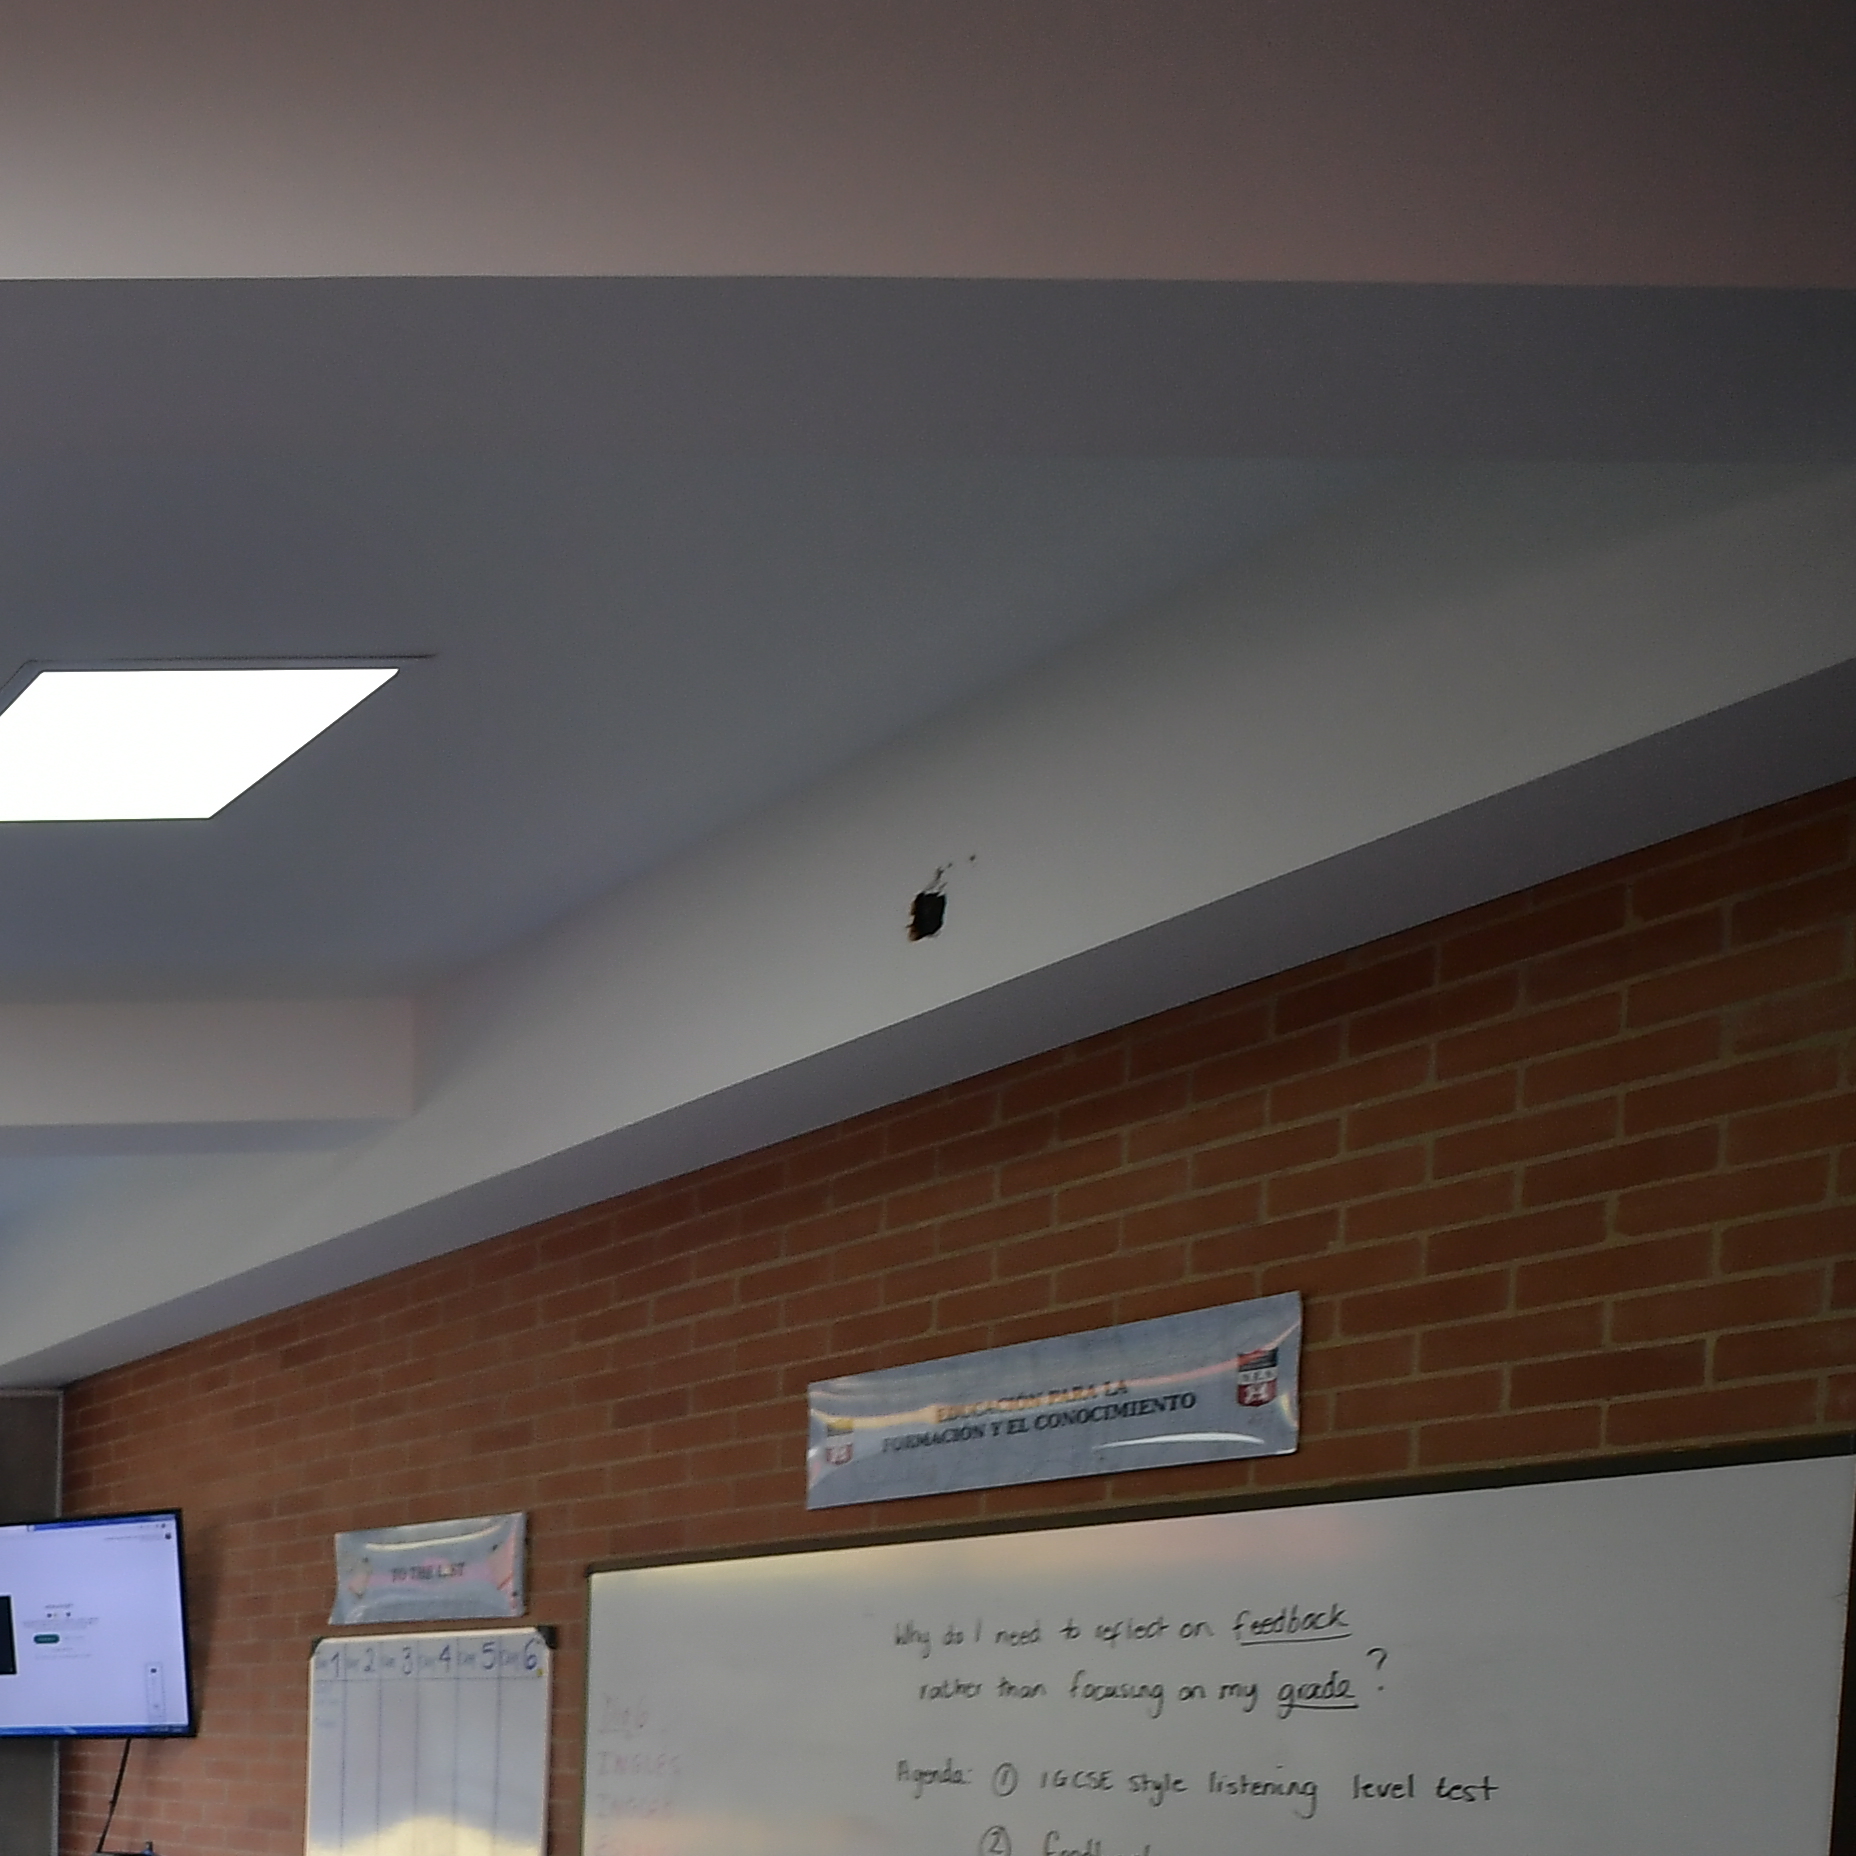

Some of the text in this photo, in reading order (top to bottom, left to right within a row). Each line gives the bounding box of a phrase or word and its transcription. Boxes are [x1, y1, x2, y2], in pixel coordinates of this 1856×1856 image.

[990, 1420, 1003, 1437] Y
[1007, 1417, 1030, 1435] EL
[1034, 1392, 1197, 1431] CONOCIMIENTO
[439, 1644, 452, 1674] 4
[482, 1641, 497, 1670] 5
[524, 1637, 538, 1671] 6
[894, 1622, 931, 1658] Why
[942, 1621, 965, 1646] do
[995, 1621, 1040, 1647] need
[1060, 1617, 1082, 1639] to
[1095, 1618, 1170, 1648] reflect
[1179, 1619, 1214, 1639] on
[1233, 1603, 1350, 1643] feedback
[918, 1678, 984, 1701] rather
[997, 1677, 1047, 1700] than
[1068, 1669, 1164, 1719] focusing
[1178, 1682, 1208, 1701] on
[1218, 1680, 1258, 1713] my
[1278, 1670, 1353, 1719] grade
[1040, 1769, 1114, 1792] IGCSE
[1128, 1770, 1188, 1807] style
[1209, 1763, 1320, 1820] listening
[1353, 1772, 1416, 1800] level
[1437, 1774, 1500, 1802] test
